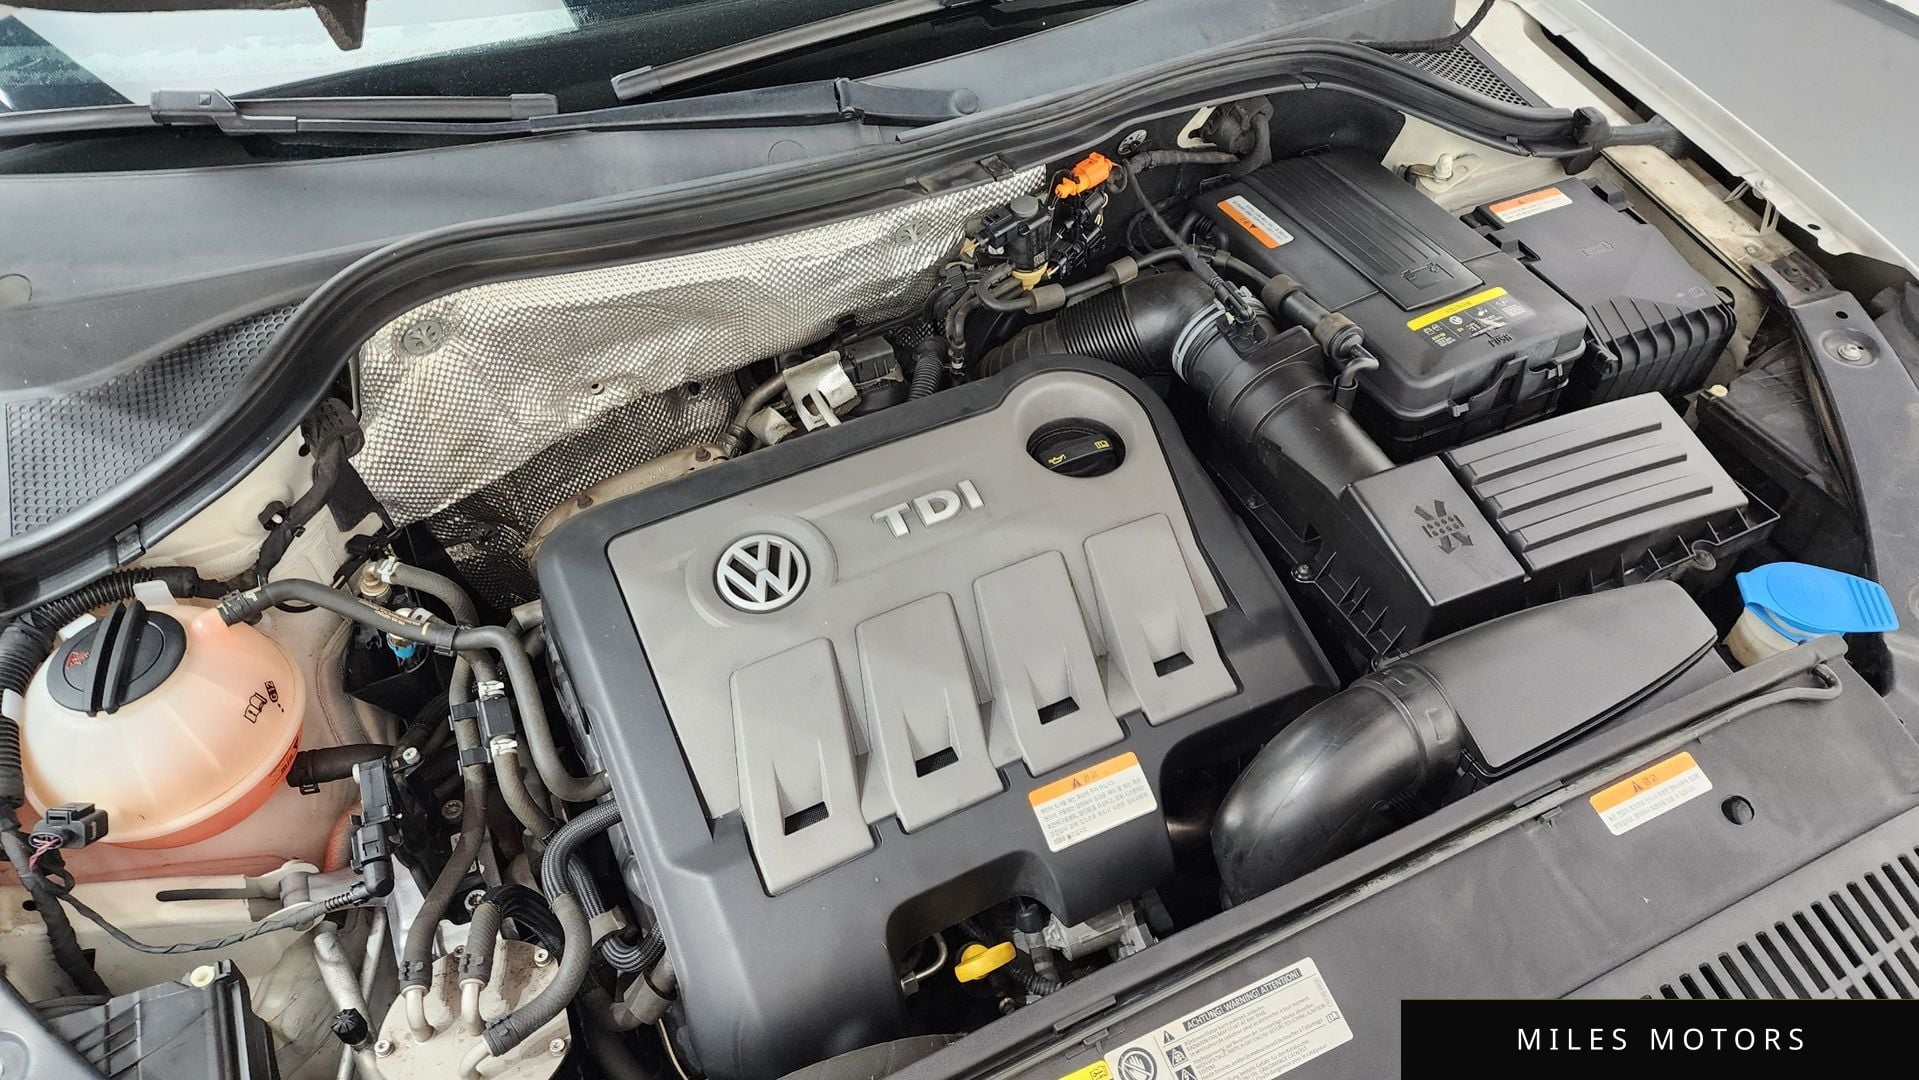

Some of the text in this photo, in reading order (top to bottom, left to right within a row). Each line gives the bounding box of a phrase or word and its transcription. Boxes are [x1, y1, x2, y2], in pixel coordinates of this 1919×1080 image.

[872, 479, 984, 540] TDI
[1186, 1006, 1224, 1030] ACHTUNG!
[1224, 989, 1260, 1011] WARNING!
[1259, 969, 1301, 995] ATTENTION!
